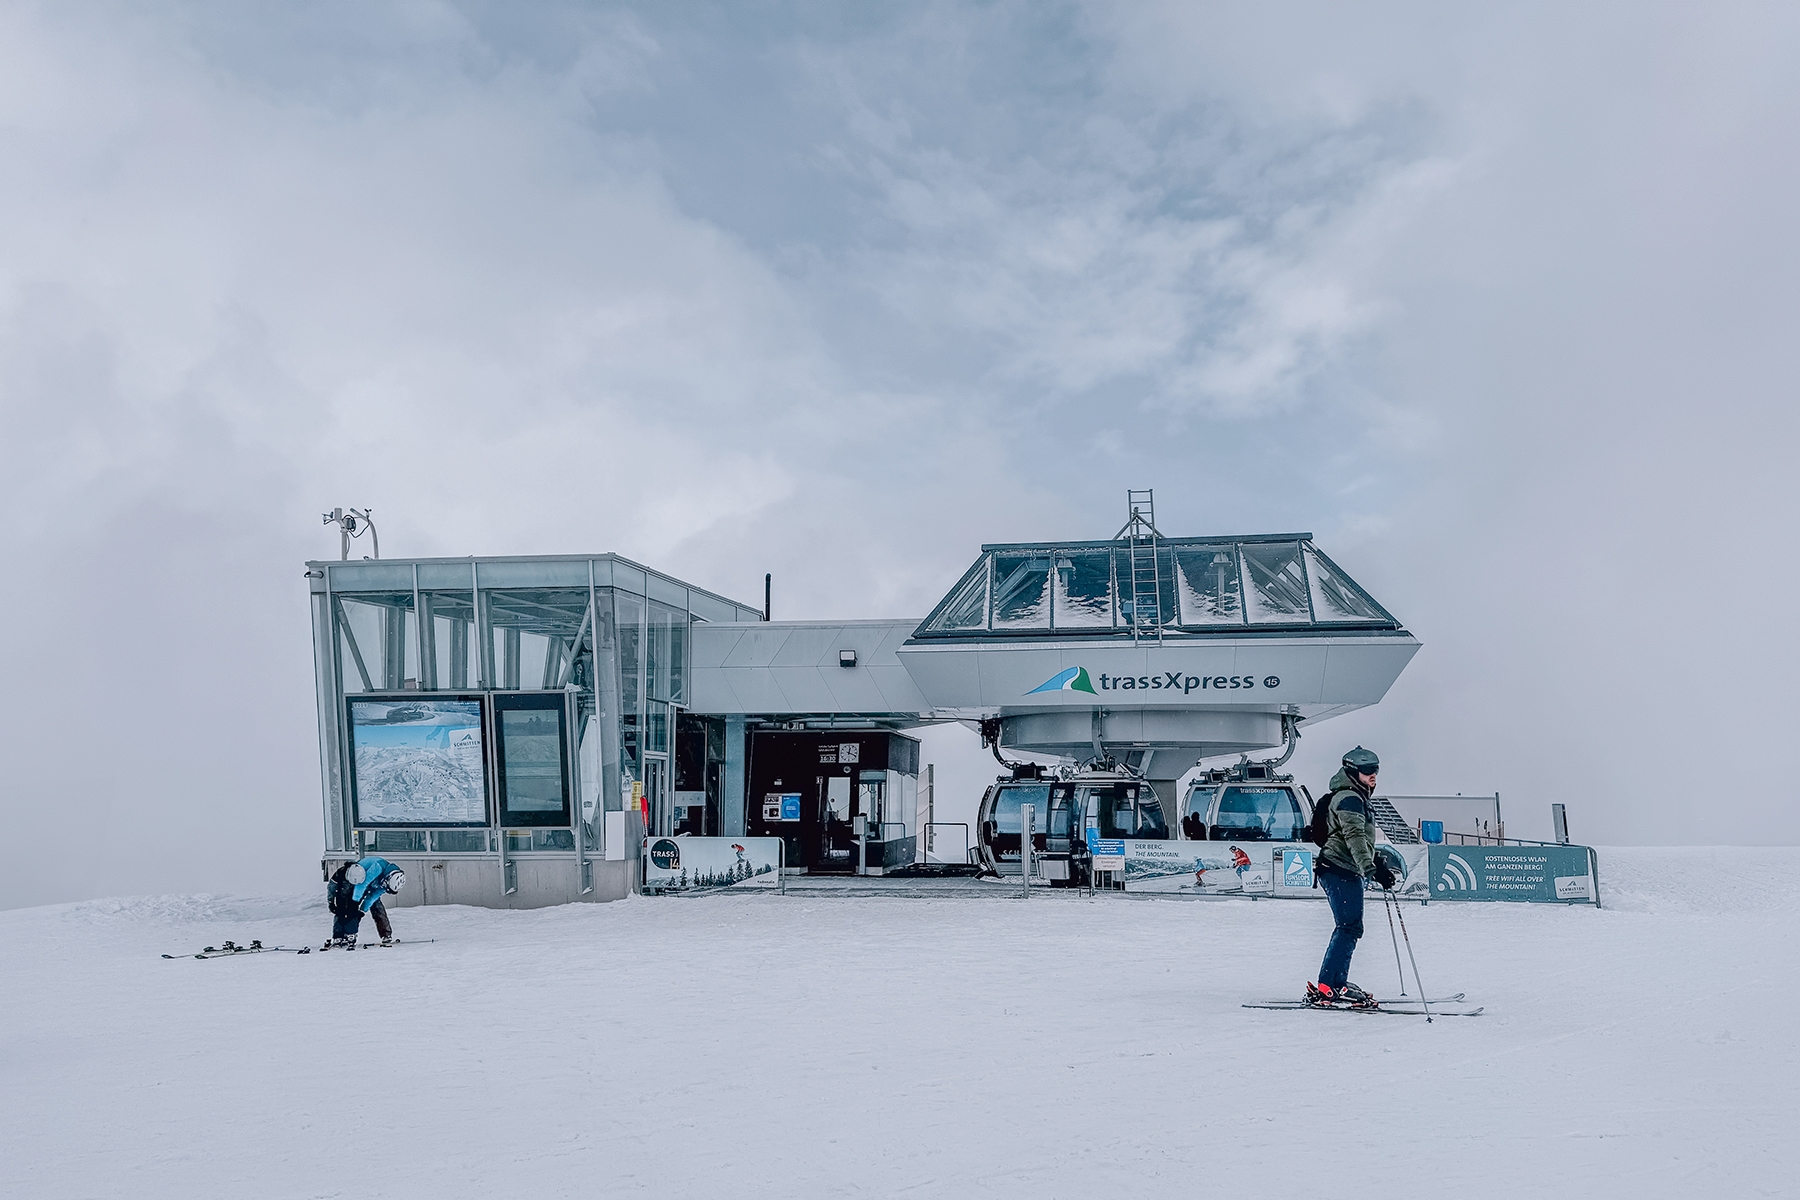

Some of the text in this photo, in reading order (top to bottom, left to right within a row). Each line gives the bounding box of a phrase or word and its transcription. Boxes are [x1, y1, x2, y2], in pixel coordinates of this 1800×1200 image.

[1099, 672, 1278, 694] trassXpress 15
[652, 850, 675, 858] TRASS
[670, 858, 680, 869] 14
